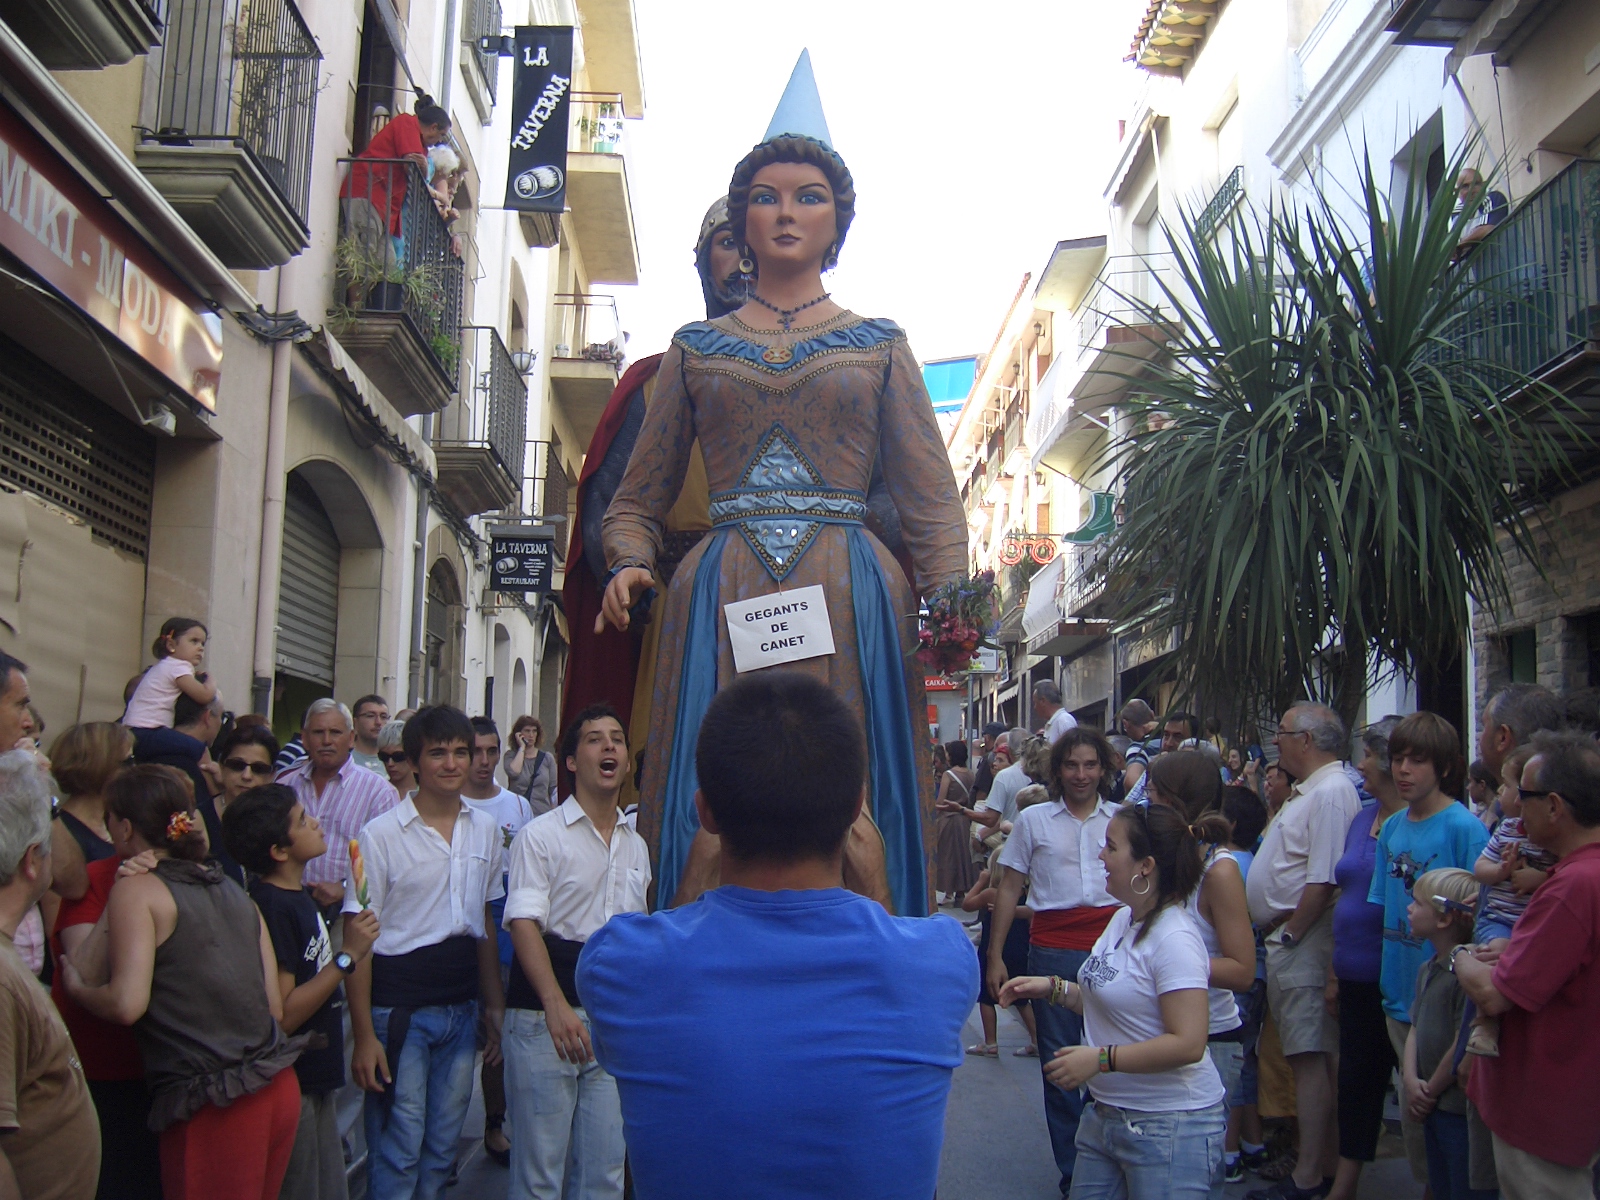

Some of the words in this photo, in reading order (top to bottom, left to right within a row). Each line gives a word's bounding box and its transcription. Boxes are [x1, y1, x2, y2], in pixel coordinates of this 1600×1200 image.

[524, 46, 550, 67] LA
[512, 74, 570, 151] TAVERNA
[0, 138, 80, 269] MIKI
[95, 233, 178, 356] MODA
[495, 543, 507, 553] LA
[508, 543, 548, 554] TAVERNA
[501, 577, 540, 585] RESTAURANT
[744, 601, 809, 622] GEGANTS
[770, 622, 789, 634] DE
[760, 635, 805, 652] CANET
[924, 679, 946, 687] CAIXA
